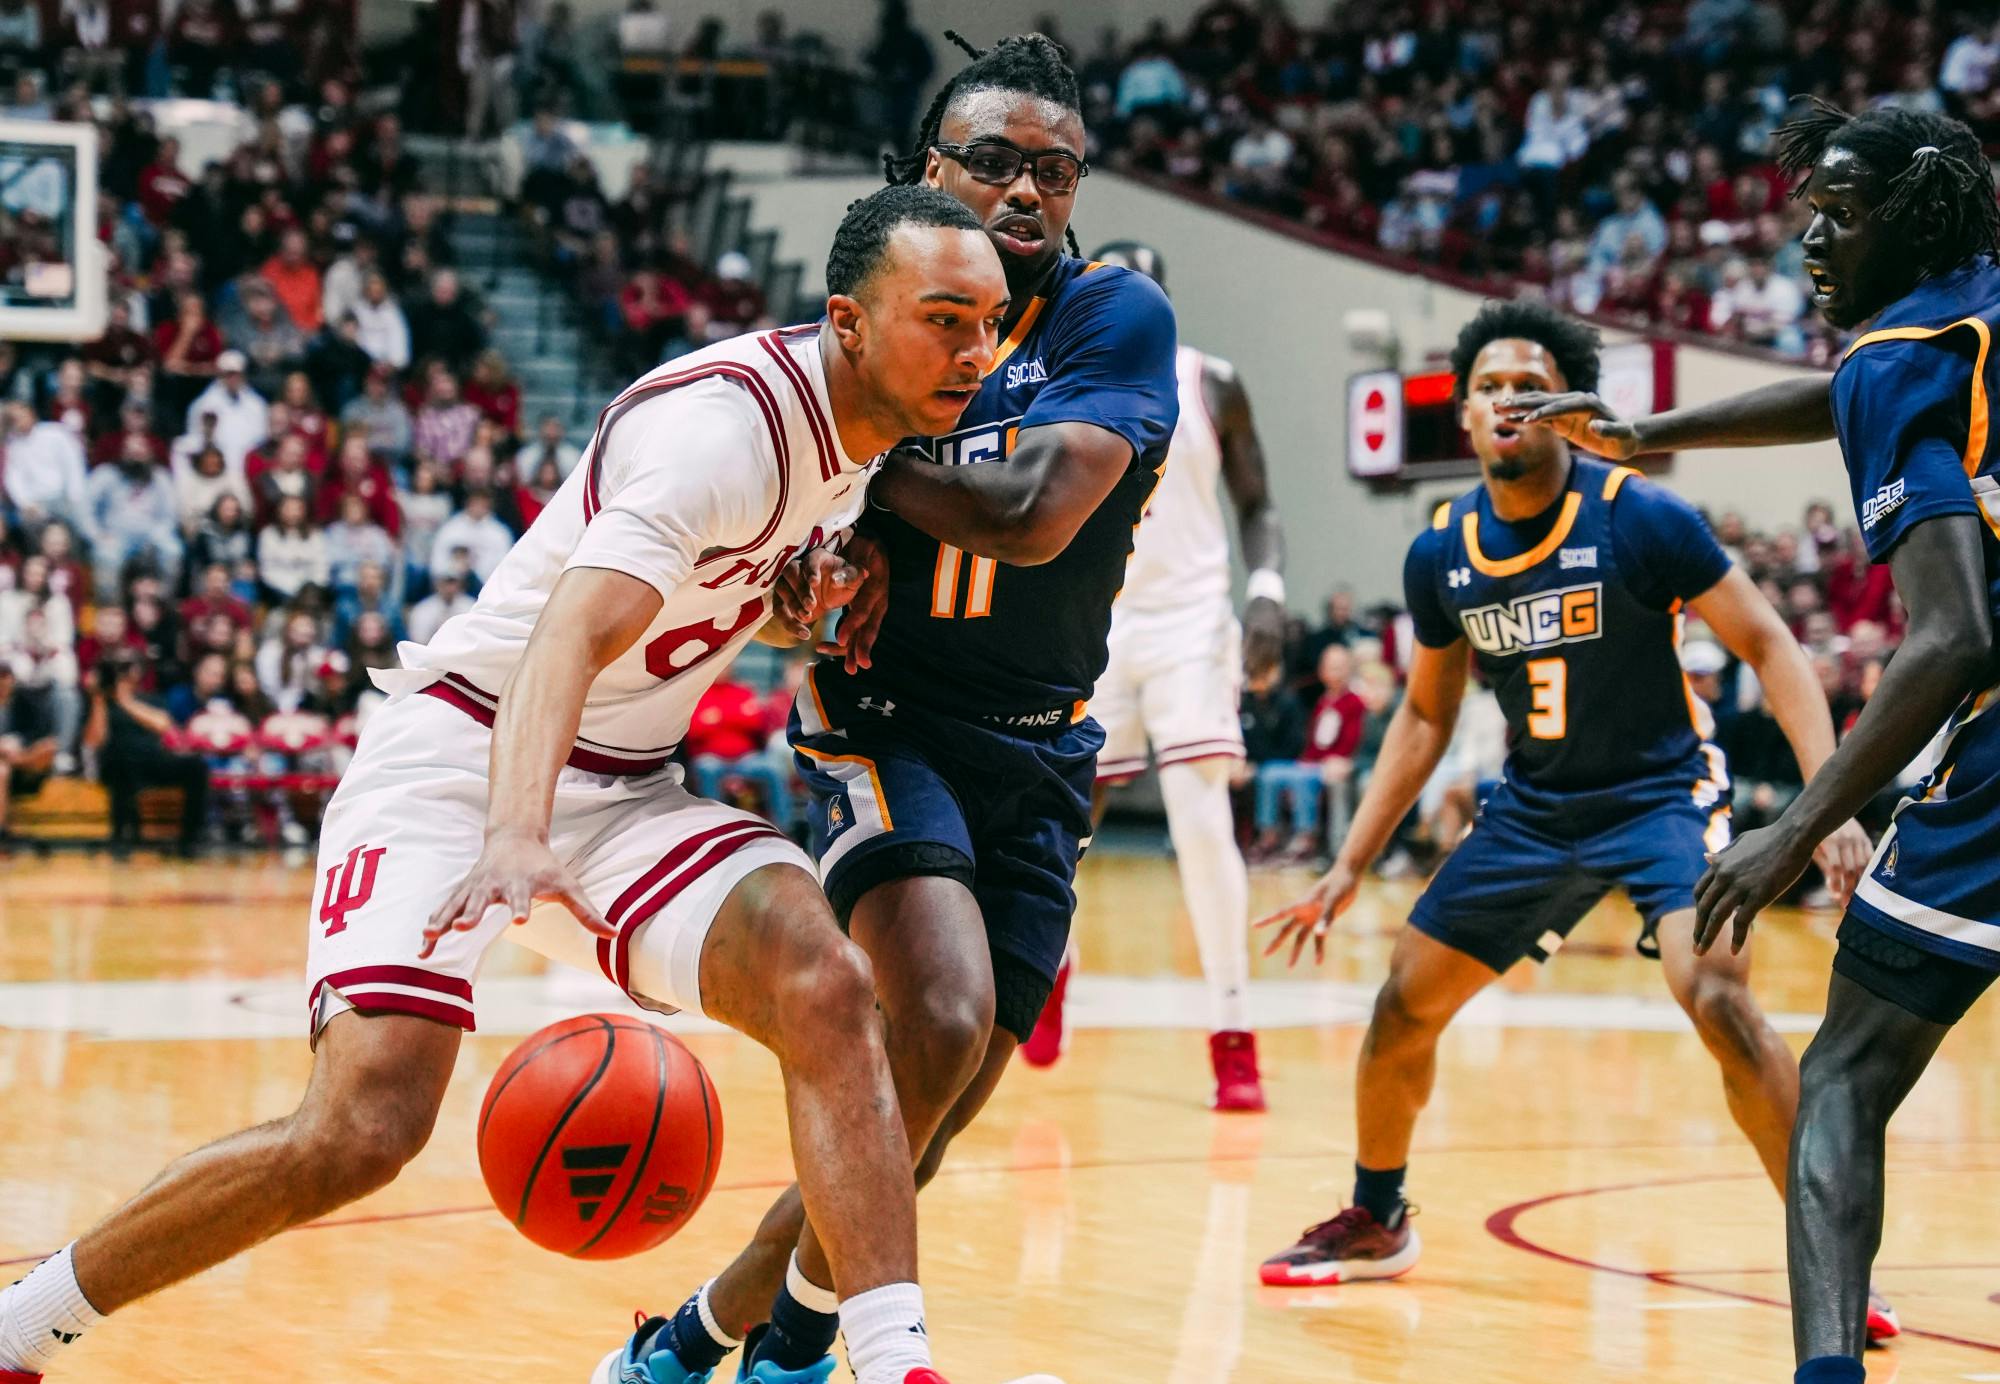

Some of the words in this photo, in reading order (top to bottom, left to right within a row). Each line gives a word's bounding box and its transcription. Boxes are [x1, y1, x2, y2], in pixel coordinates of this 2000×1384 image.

[1006, 356, 1049, 389] SOCON
[930, 541, 998, 619] 11
[1460, 582, 1602, 656] UNCG
[1526, 657, 1567, 739] 3
